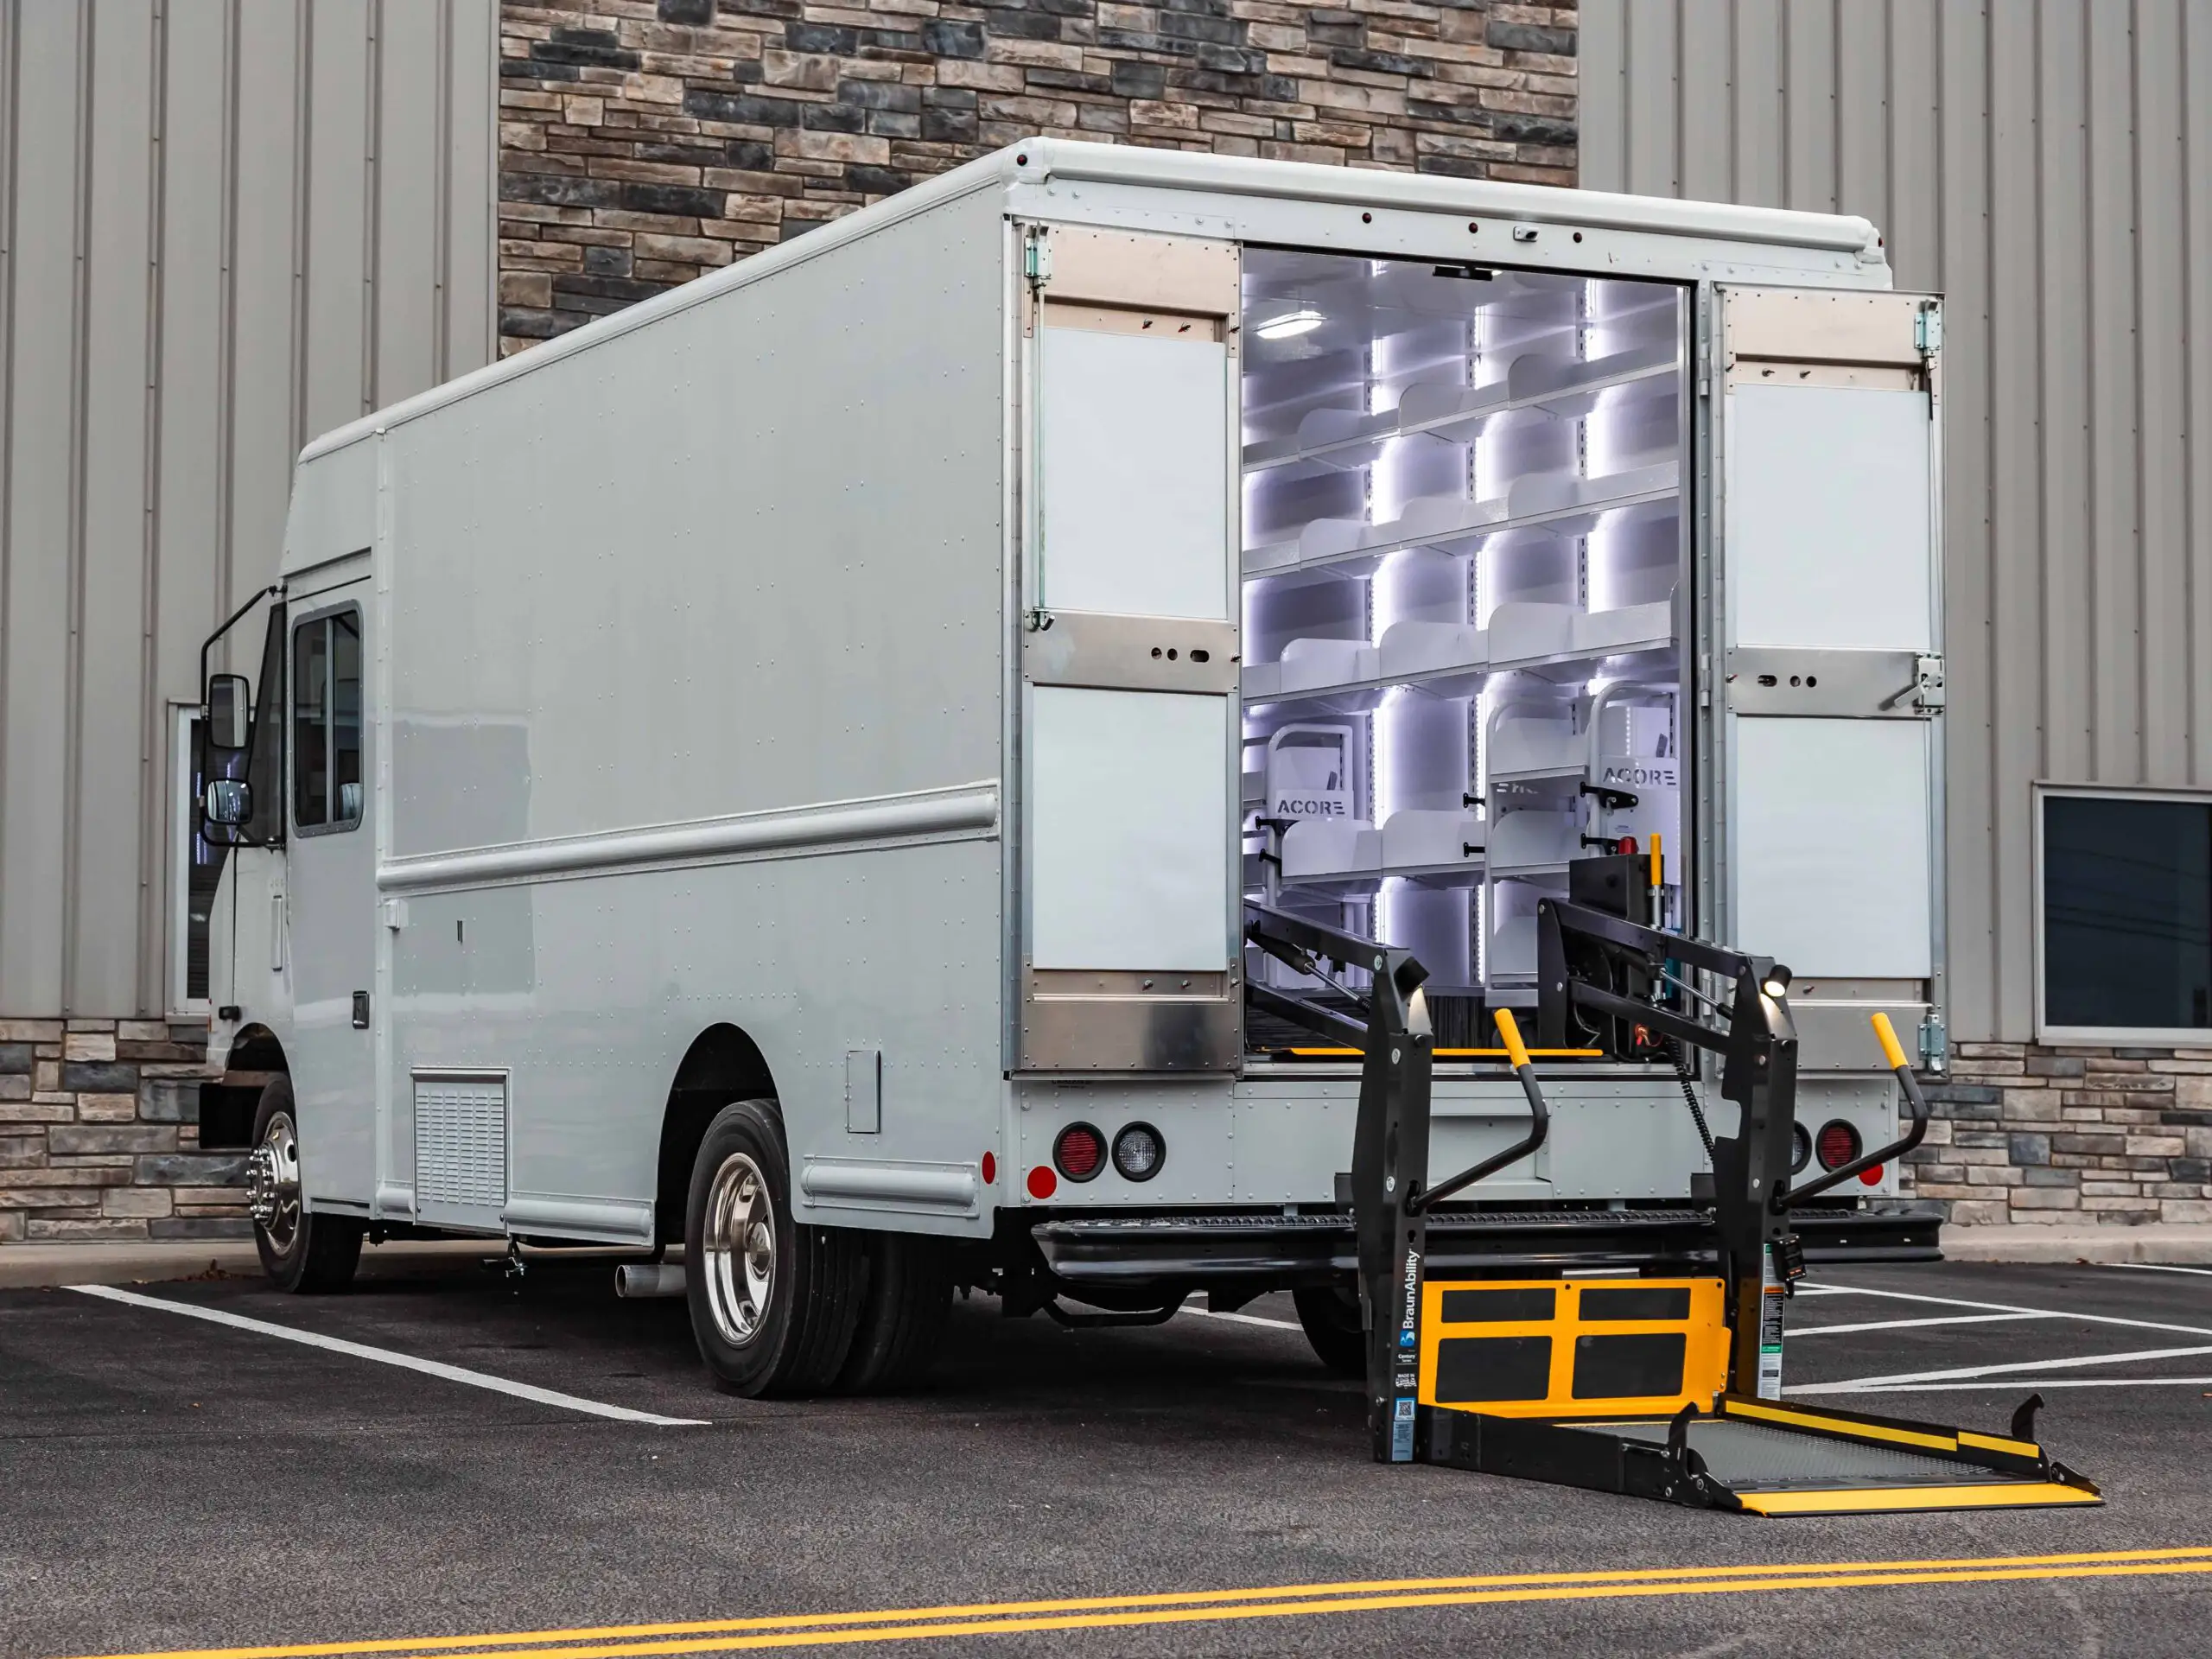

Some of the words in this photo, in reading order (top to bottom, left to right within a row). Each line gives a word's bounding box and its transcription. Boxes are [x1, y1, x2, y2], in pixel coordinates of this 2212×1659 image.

[1603, 767, 1676, 785] ACORE
[1278, 799, 1345, 815] ACORE
[1402, 1249, 1421, 1329] BraunAbility
